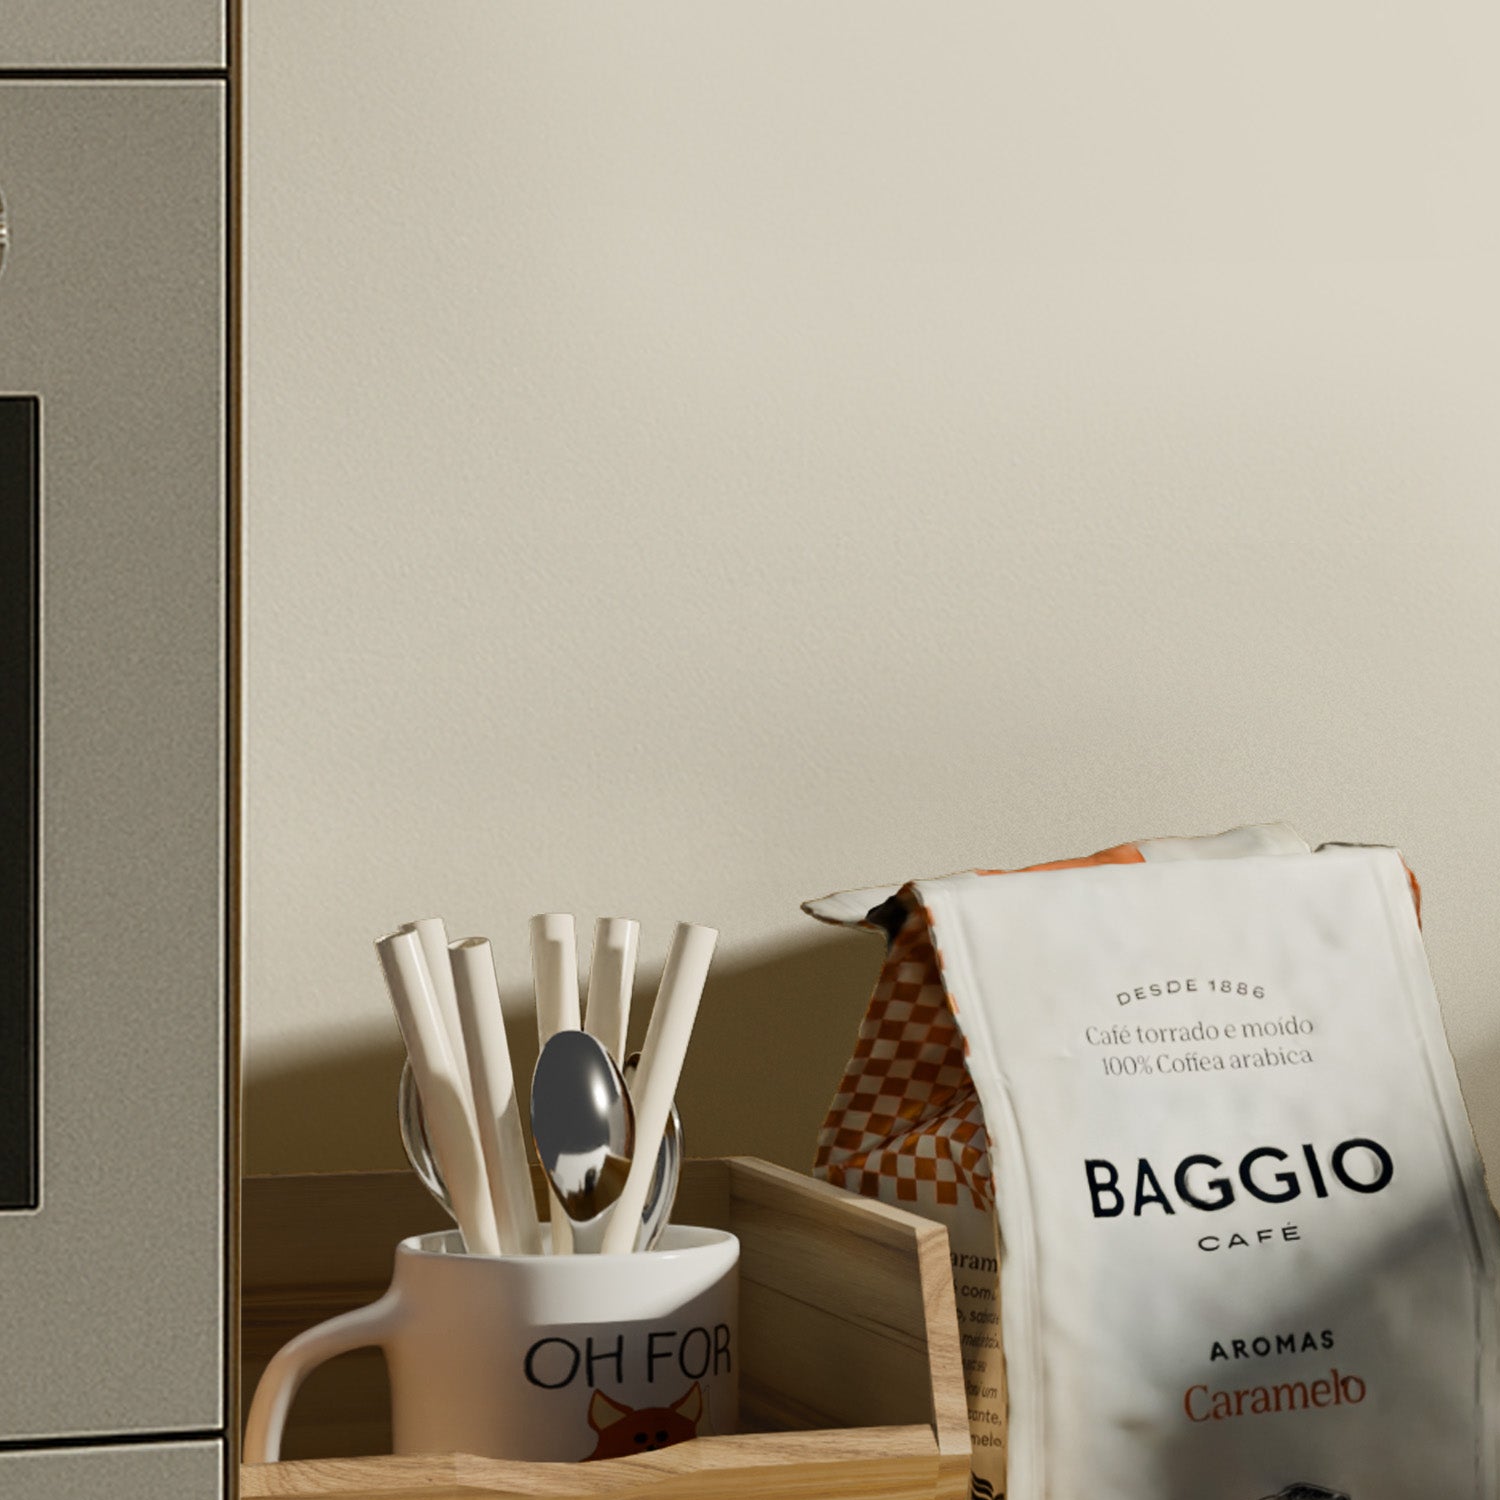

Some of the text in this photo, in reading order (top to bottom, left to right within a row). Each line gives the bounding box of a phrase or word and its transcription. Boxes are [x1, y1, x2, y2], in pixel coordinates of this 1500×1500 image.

[1116, 978, 1266, 1006] DESDE 1886
[1086, 1016, 1314, 1046] Café torrado e moído
[1102, 1047, 1314, 1077] 100% Coffea arabica
[1084, 1137, 1395, 1218] BAGGIO
[1197, 1221, 1302, 1252] CAFÉ
[950, 1252, 998, 1274] aram
[523, 1323, 732, 1390] OH FOR
[1209, 1329, 1335, 1362] AROMAS
[1183, 1367, 1367, 1423] Caramelo
